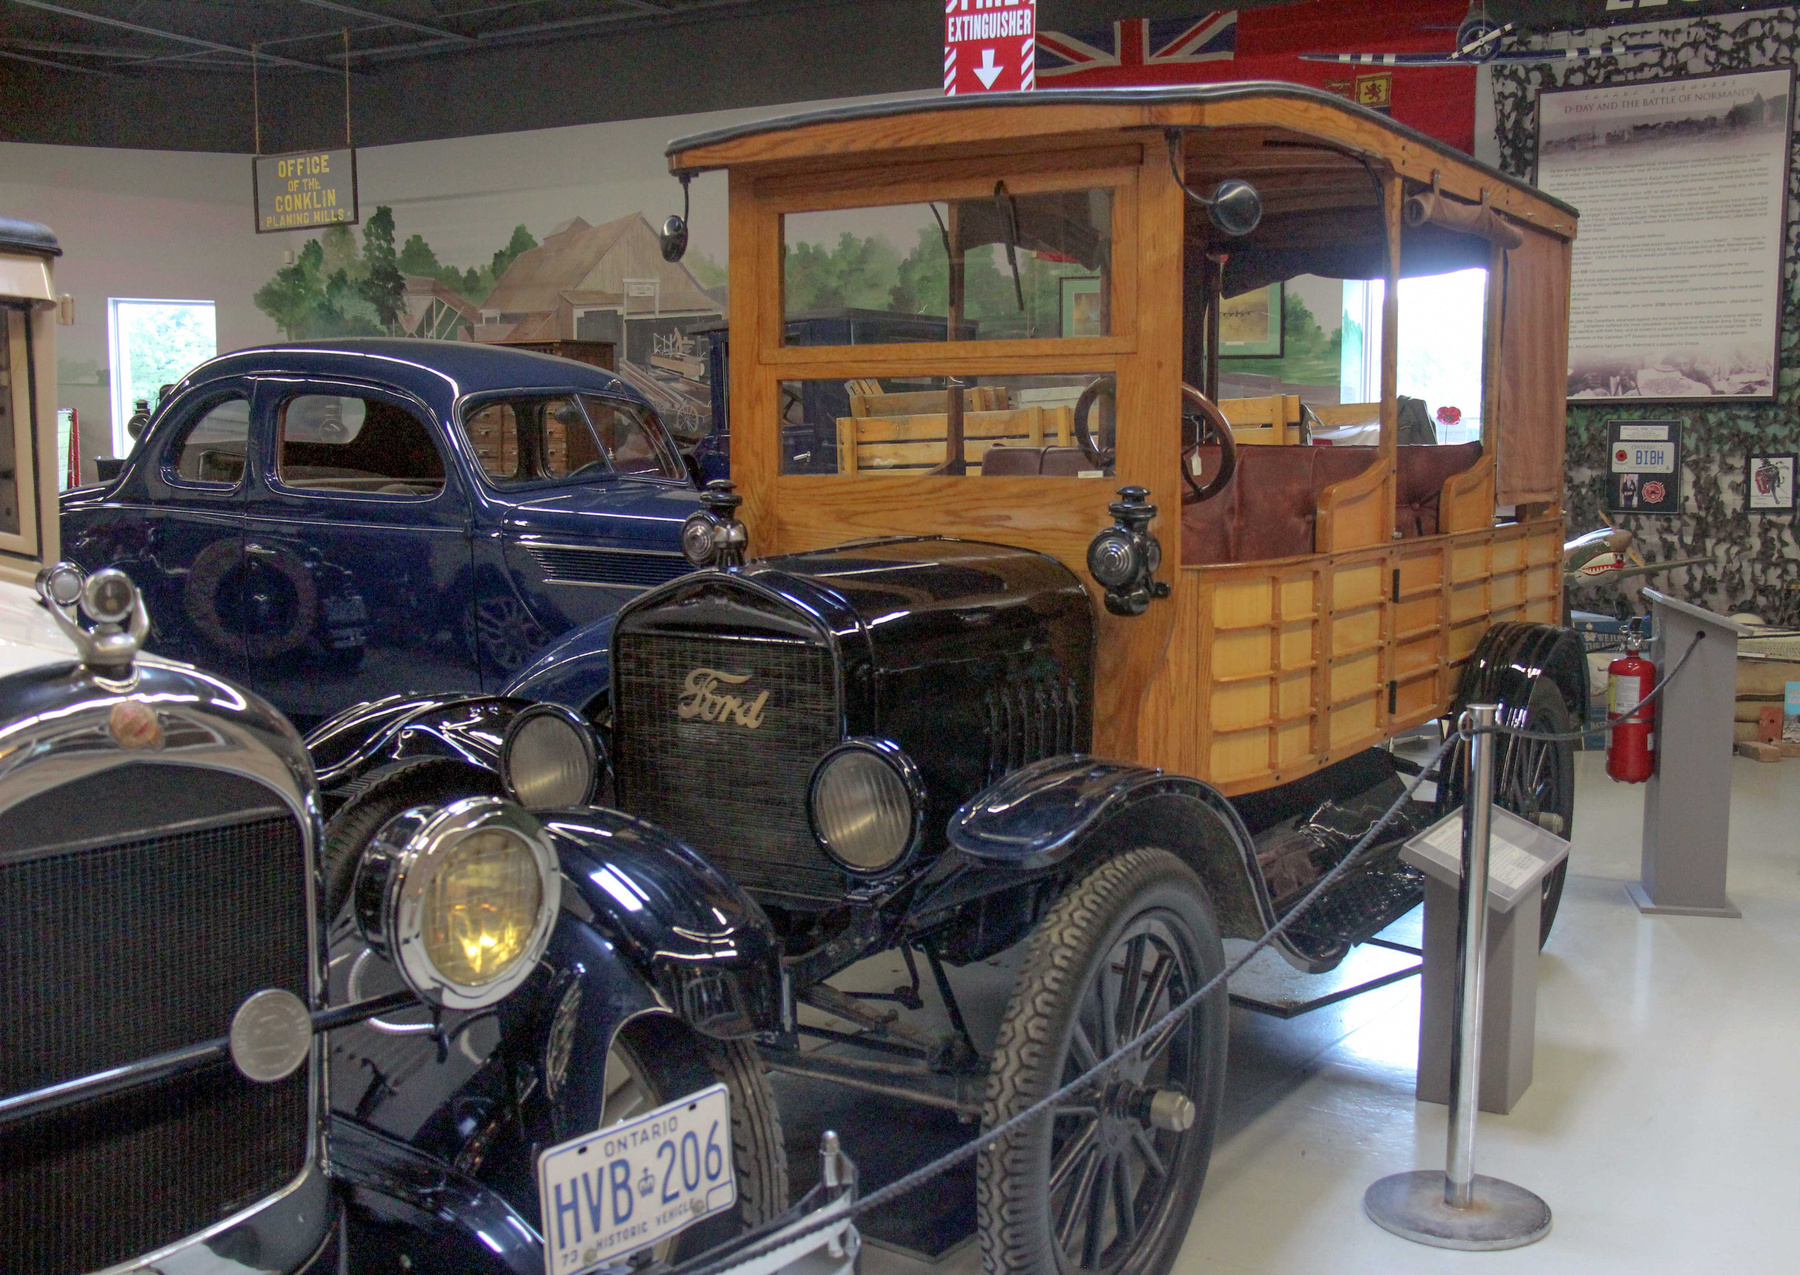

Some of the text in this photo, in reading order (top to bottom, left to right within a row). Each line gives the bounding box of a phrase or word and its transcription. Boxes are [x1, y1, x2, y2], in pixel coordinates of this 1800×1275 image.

[947, 9, 1032, 43] EXTINGUISHER
[1564, 87, 1757, 114] D-DAY AND THE BATTLE OF NORMANDY
[278, 154, 330, 178] OFFICE
[287, 177, 321, 192] OF THE
[275, 189, 336, 212] CONKLIN
[266, 208, 344, 228] PLANING MILLS
[1636, 450, 1664, 465] BIBH
[678, 668, 769, 728] Ford
[605, 1116, 678, 1158] ONTARIO
[554, 1119, 722, 1250] HVB 206
[561, 1197, 695, 1267] 73 HISTORIC VEHICLE
